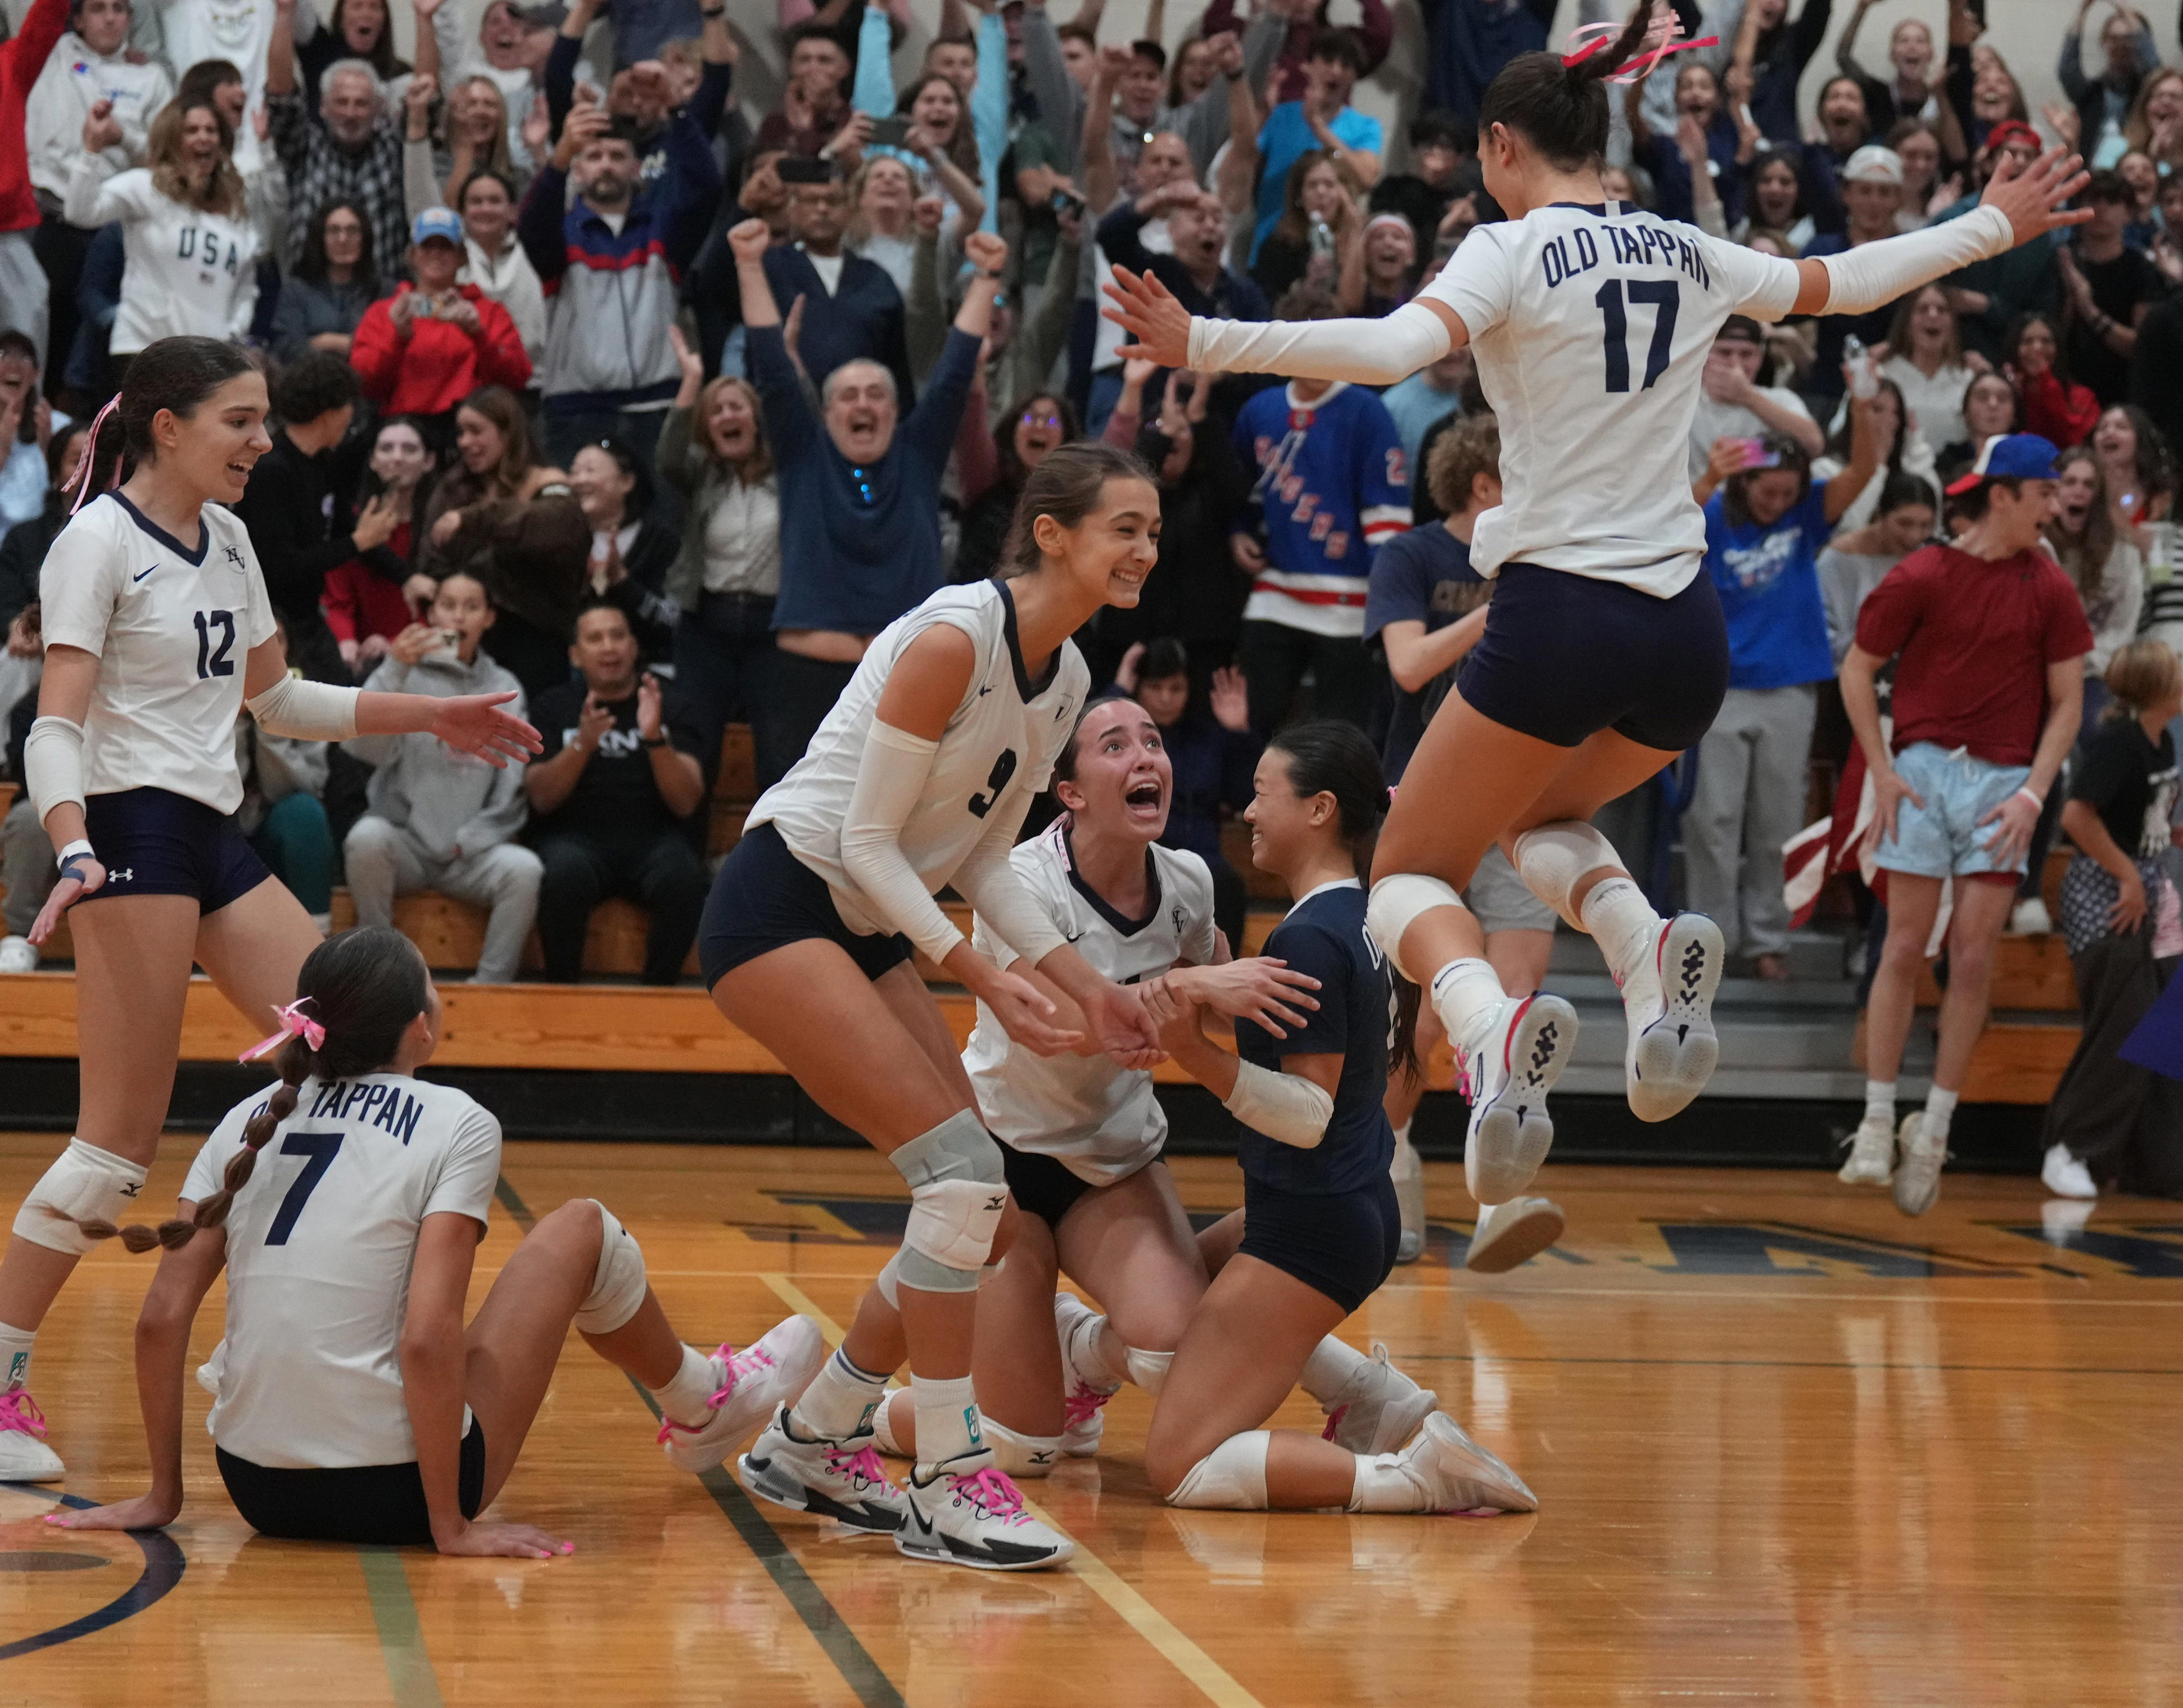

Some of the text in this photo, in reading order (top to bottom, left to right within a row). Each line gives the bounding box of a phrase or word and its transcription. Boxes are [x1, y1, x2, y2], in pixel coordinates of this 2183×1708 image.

[179, 228, 237, 276] USA
[1542, 225, 1709, 292] OLD TAPPAN
[1596, 279, 1680, 392] 17
[193, 610, 235, 680] 12
[968, 747, 1016, 819] 9
[308, 1081, 423, 1146] TAPPAN
[264, 1133, 345, 1245] 7
